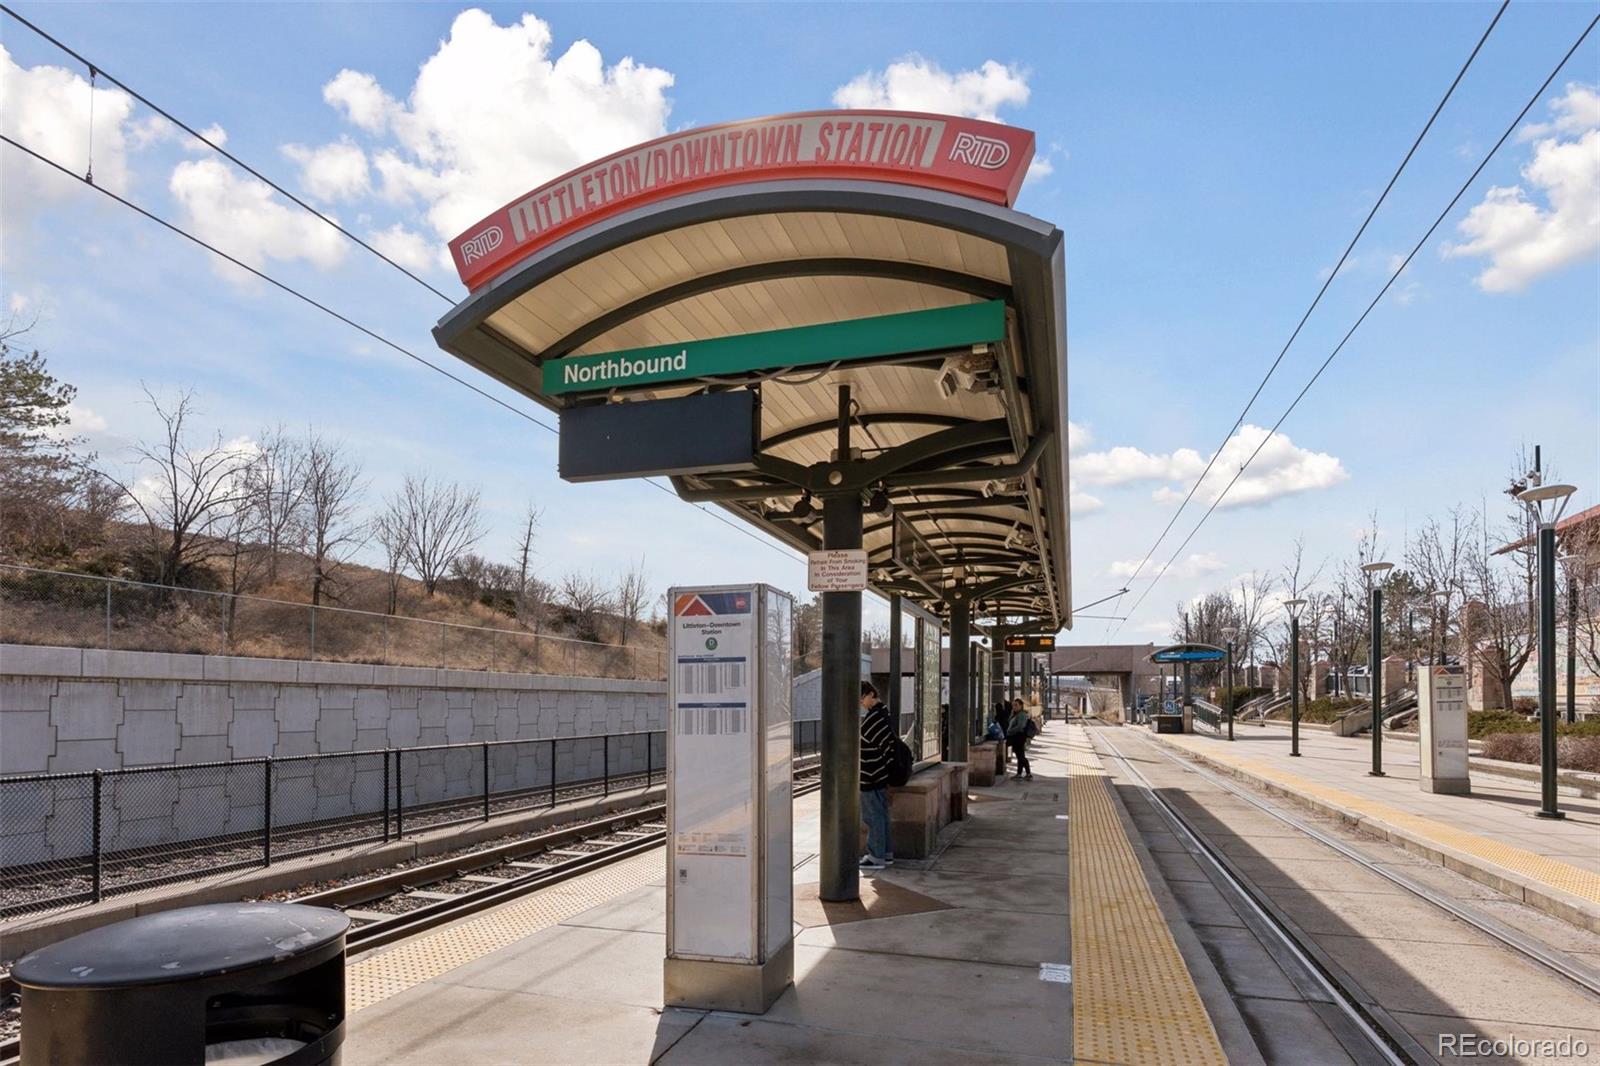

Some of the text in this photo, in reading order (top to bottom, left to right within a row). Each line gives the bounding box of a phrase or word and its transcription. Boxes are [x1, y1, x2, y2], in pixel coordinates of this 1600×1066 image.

[948, 131, 1011, 170] RTD
[518, 120, 934, 235] LITTLETON/DOWNTOWN STATION
[460, 225, 504, 267] RTD
[563, 350, 688, 385] Northbound
